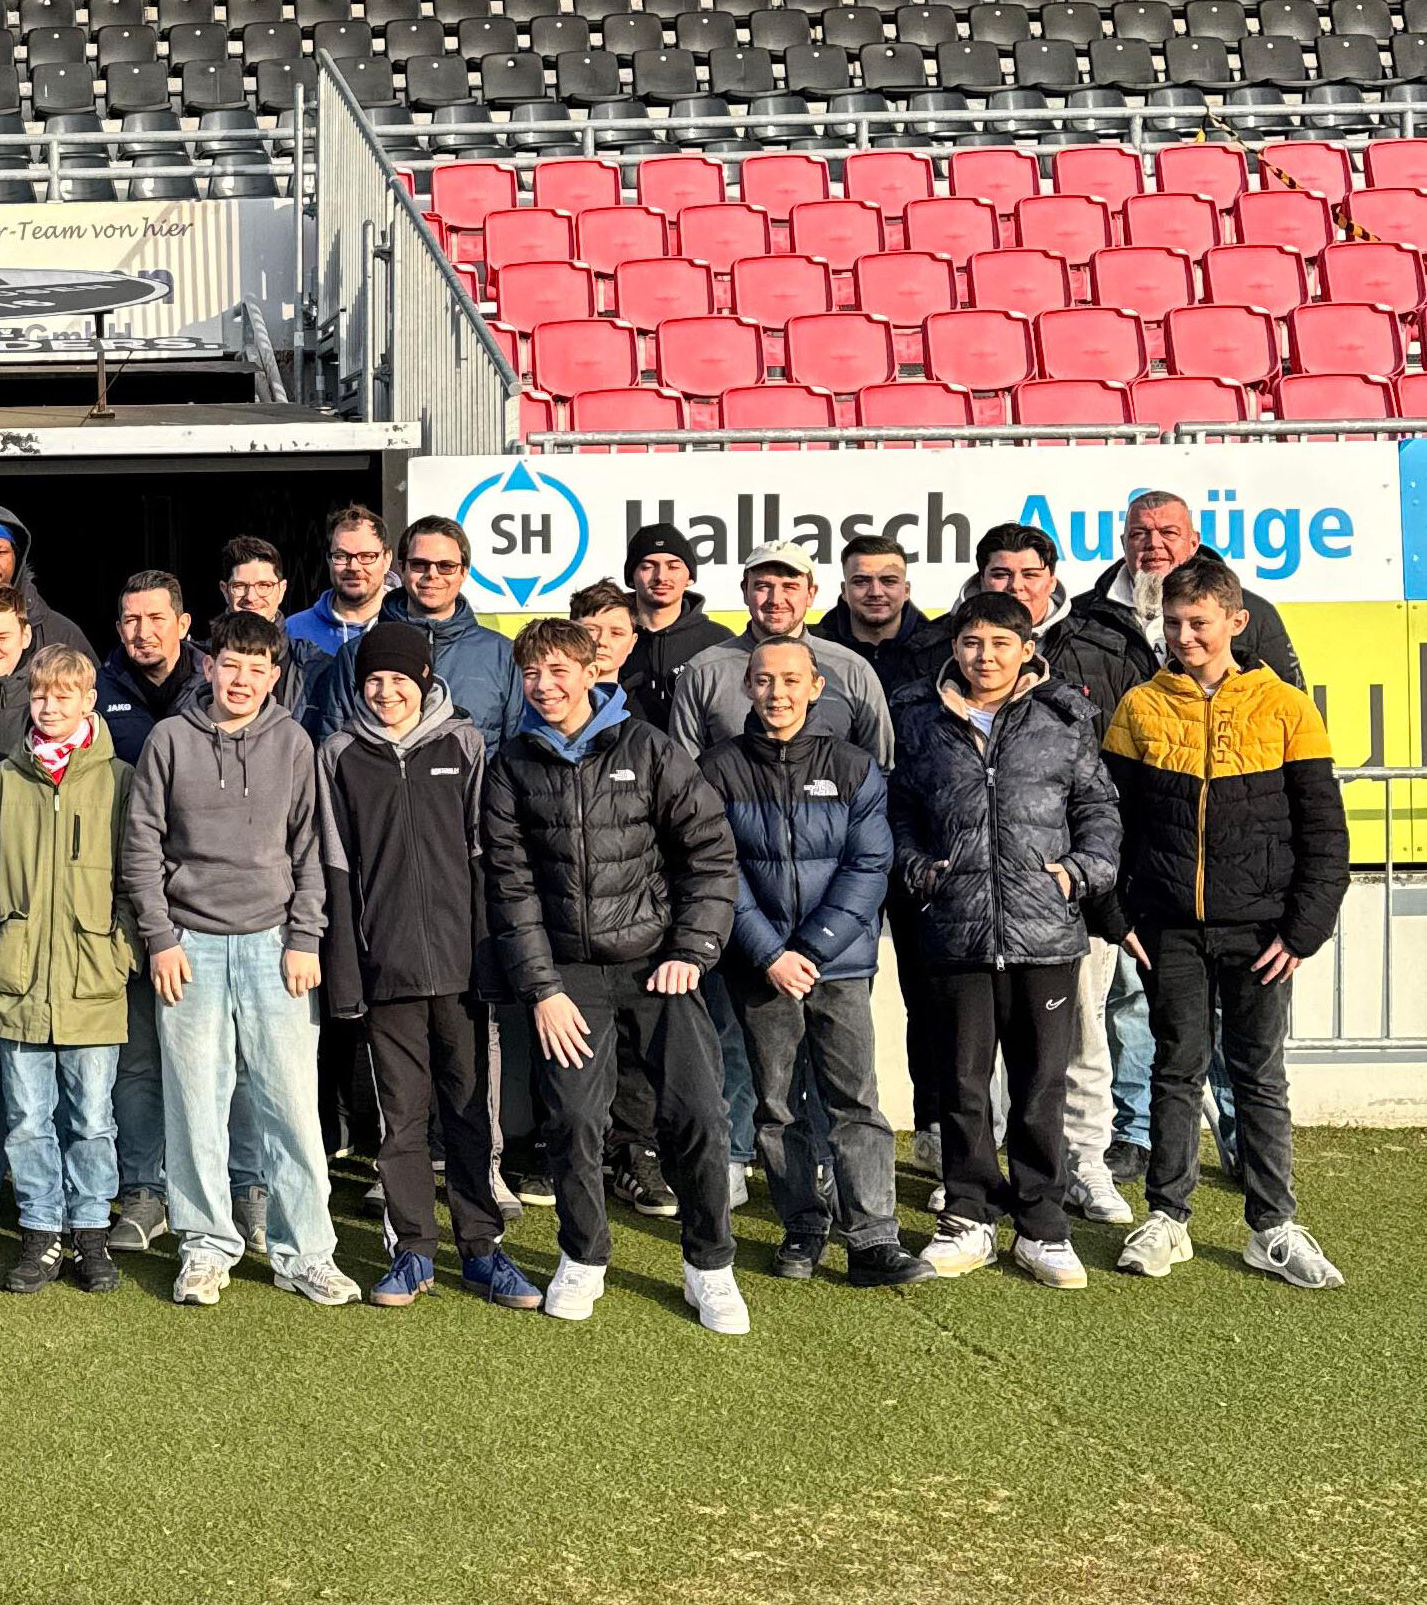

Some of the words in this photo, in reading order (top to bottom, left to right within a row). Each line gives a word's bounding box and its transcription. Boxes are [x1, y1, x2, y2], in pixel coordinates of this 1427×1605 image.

[92, 223, 136, 240] von
[141, 216, 194, 239] hier
[491, 513, 552, 555] SH
[1014, 487, 1355, 580] Auüge
[106, 703, 132, 712] JAKO
